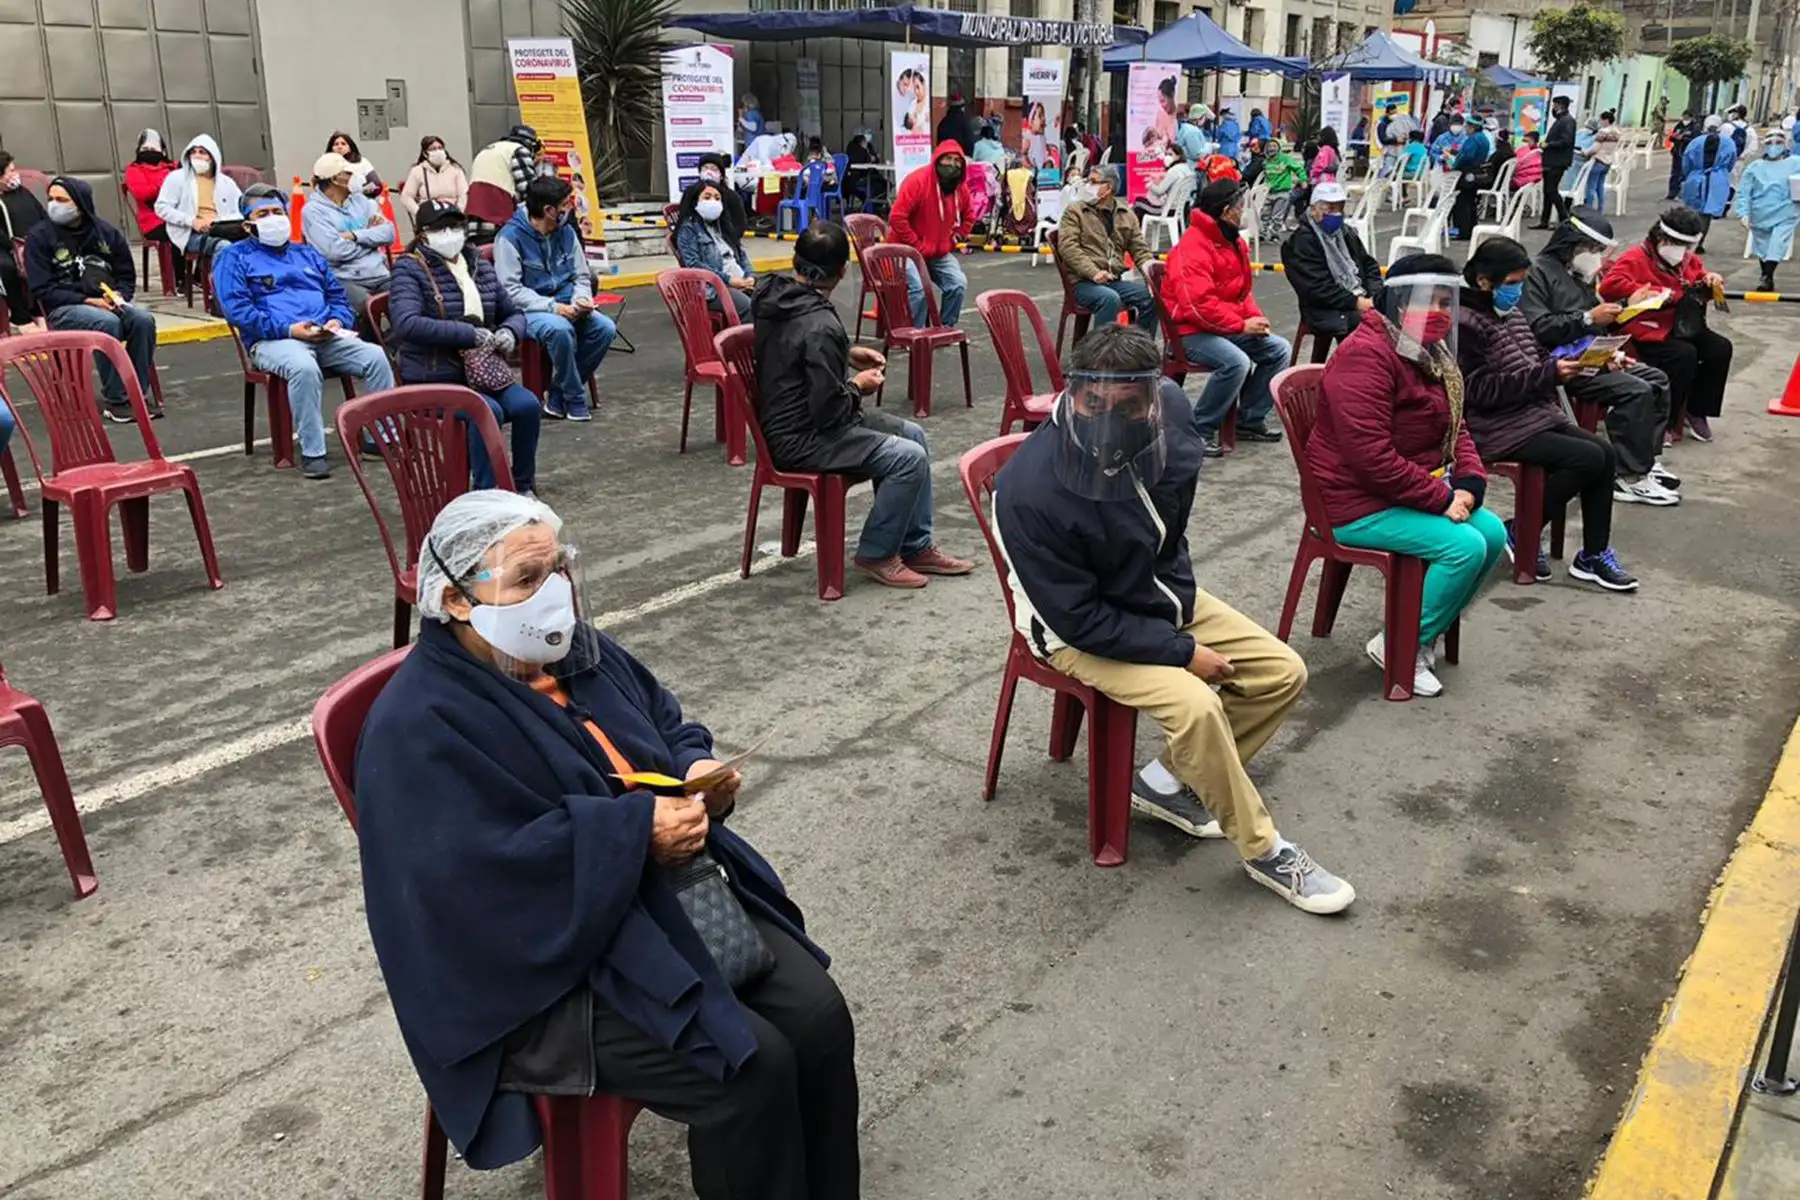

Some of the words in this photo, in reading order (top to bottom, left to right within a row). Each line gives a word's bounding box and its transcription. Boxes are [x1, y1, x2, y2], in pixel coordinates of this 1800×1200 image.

[960, 13, 1042, 42] MUNICIPALIDAD
[1045, 23, 1058, 42] DE
[1060, 24, 1071, 43] LA
[1073, 24, 1114, 44] VICTORIA
[555, 48, 569, 57] DEL
[514, 58, 571, 67] CORONAVIRUS
[672, 84, 724, 94] CORONAVIRUS
